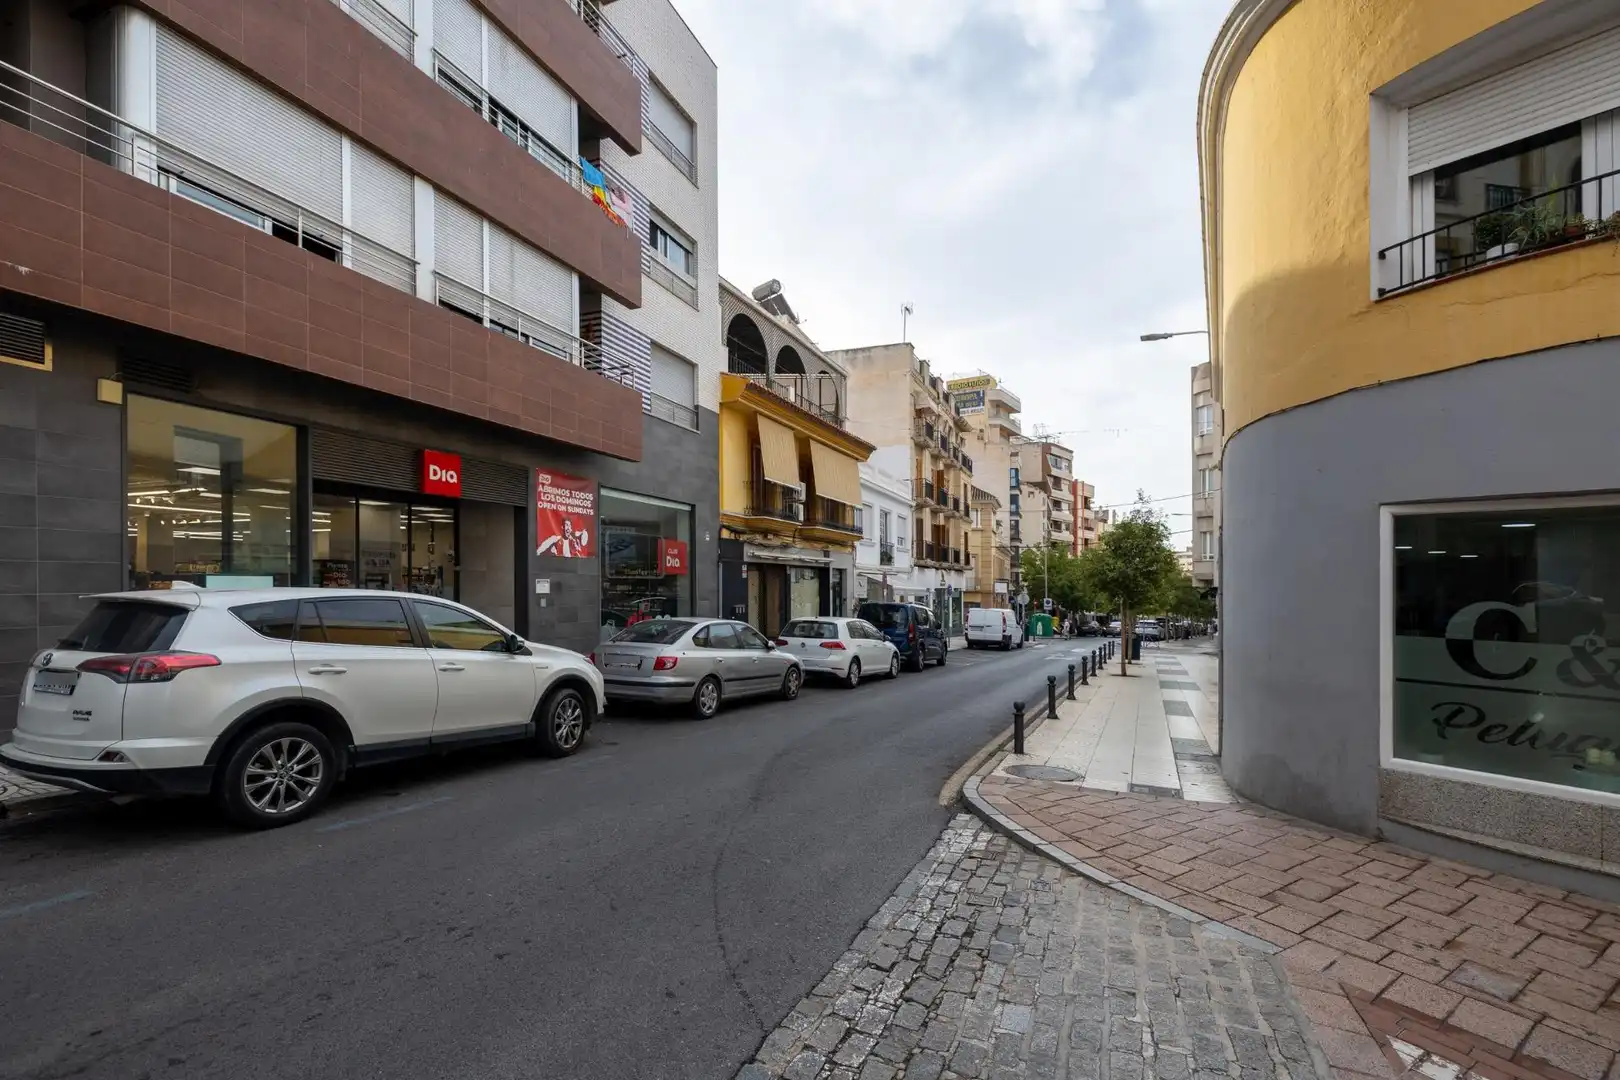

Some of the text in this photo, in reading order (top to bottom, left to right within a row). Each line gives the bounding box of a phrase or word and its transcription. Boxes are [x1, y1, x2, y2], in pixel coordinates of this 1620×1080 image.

[428, 464, 458, 484] Dia
[538, 485, 593, 500] ABRIMOS TODOS
[541, 493, 591, 507] LOS DOMINGOS
[538, 502, 556, 510] OPEN
[567, 506, 594, 516] SUNDAYS
[666, 556, 680, 567] Dia
[1445, 600, 1537, 681] C
